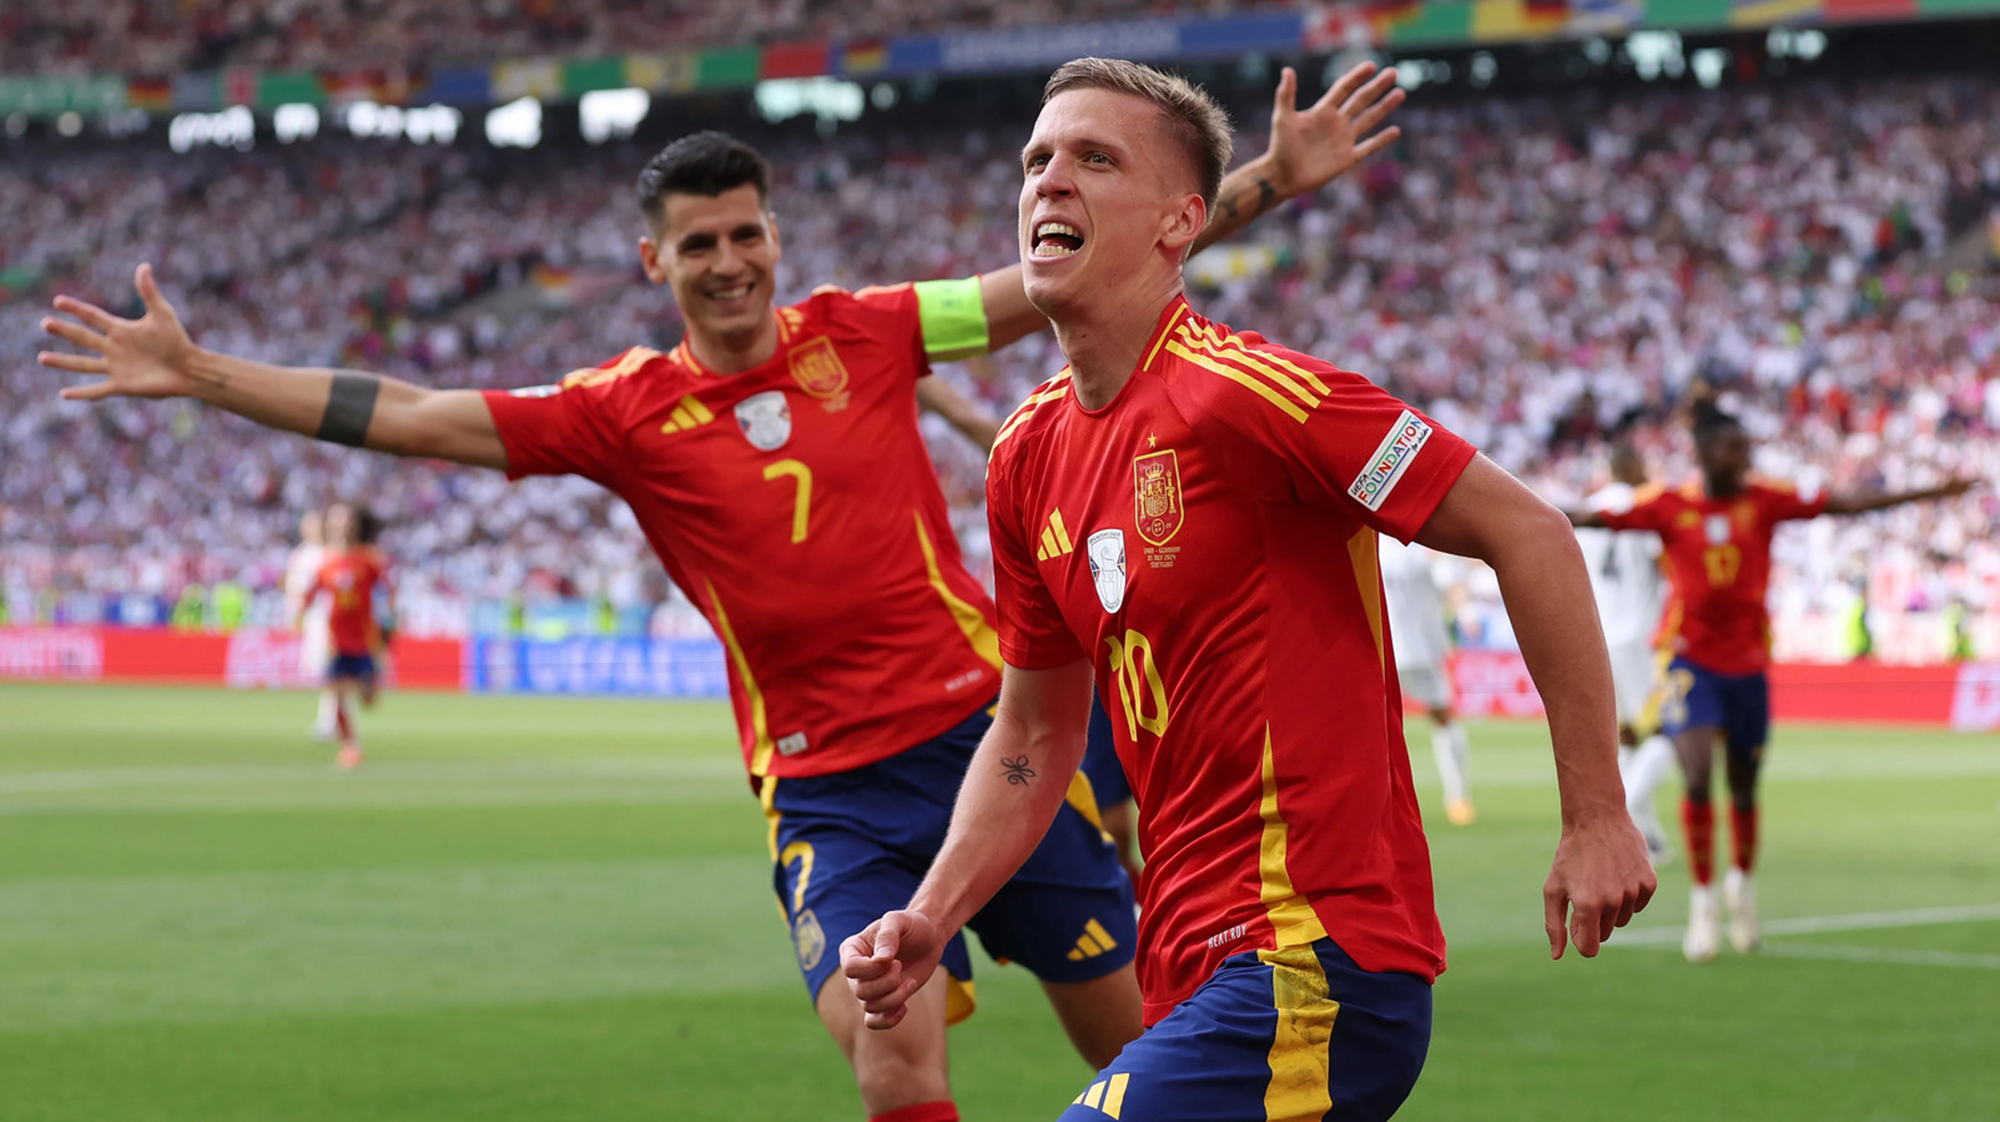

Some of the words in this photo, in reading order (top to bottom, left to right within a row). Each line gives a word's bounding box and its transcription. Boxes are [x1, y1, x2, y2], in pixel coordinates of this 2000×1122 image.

[763, 458, 812, 544] 7
[1350, 474, 1369, 496] UEFA
[1103, 628, 1169, 742] 10
[780, 841, 815, 912] 7
